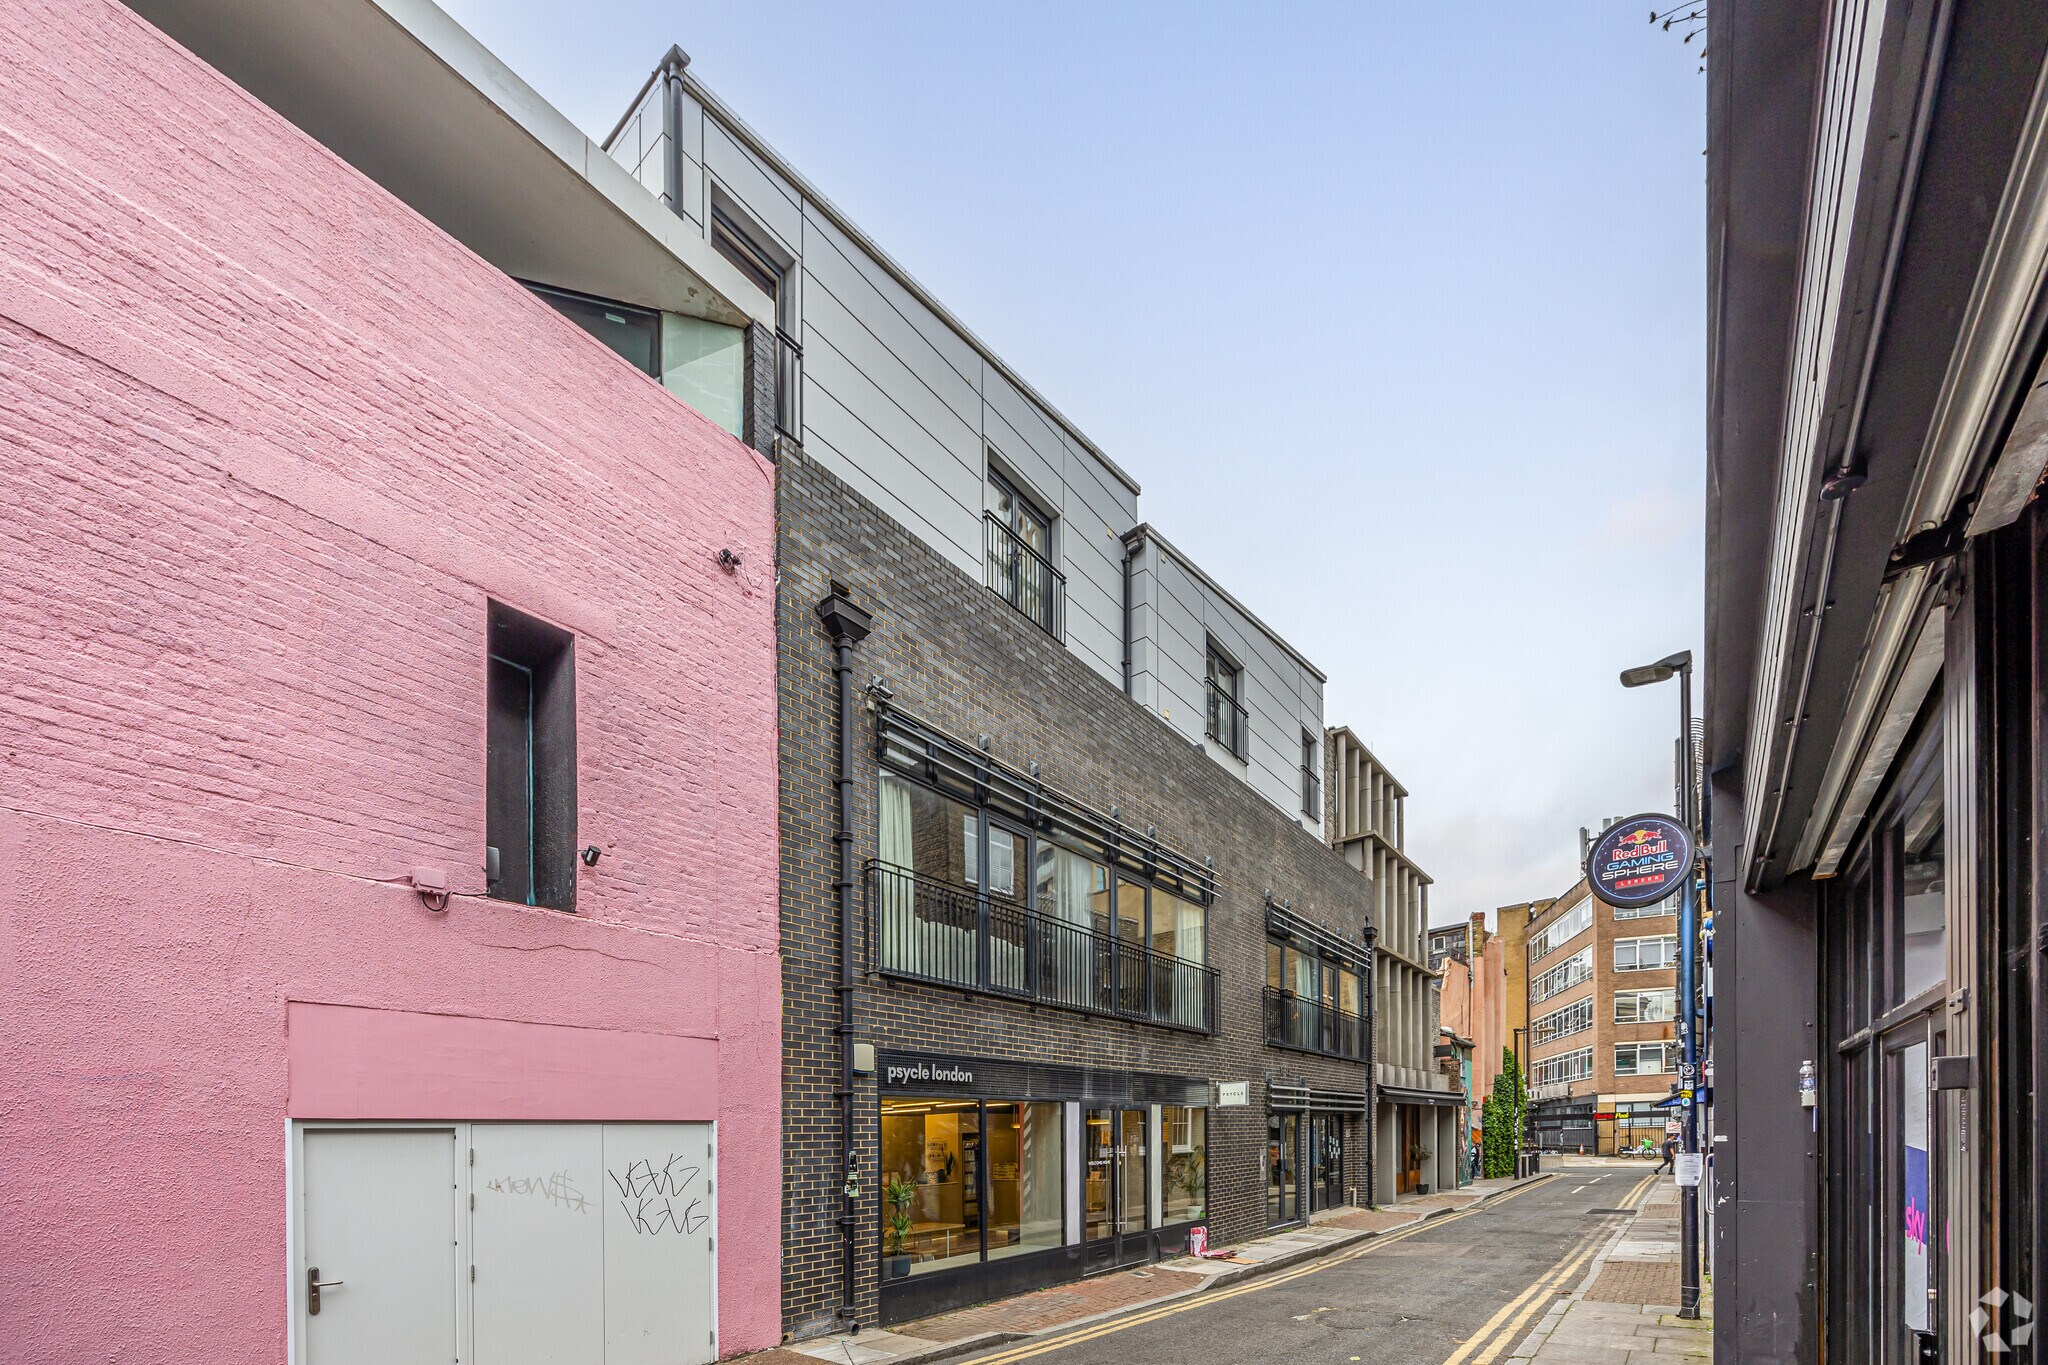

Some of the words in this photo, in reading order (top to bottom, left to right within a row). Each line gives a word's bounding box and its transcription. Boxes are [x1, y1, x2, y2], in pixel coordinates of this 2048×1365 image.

[1613, 845, 1639, 861] Red
[1640, 840, 1667, 855] Bull
[1602, 860, 1679, 881] SPHERE
[1607, 852, 1674, 871] GAMING
[1620, 875, 1659, 886] LONDON
[887, 1062, 930, 1085] psycle
[932, 1063, 973, 1082] london
[1905, 1196, 1925, 1255] sky
